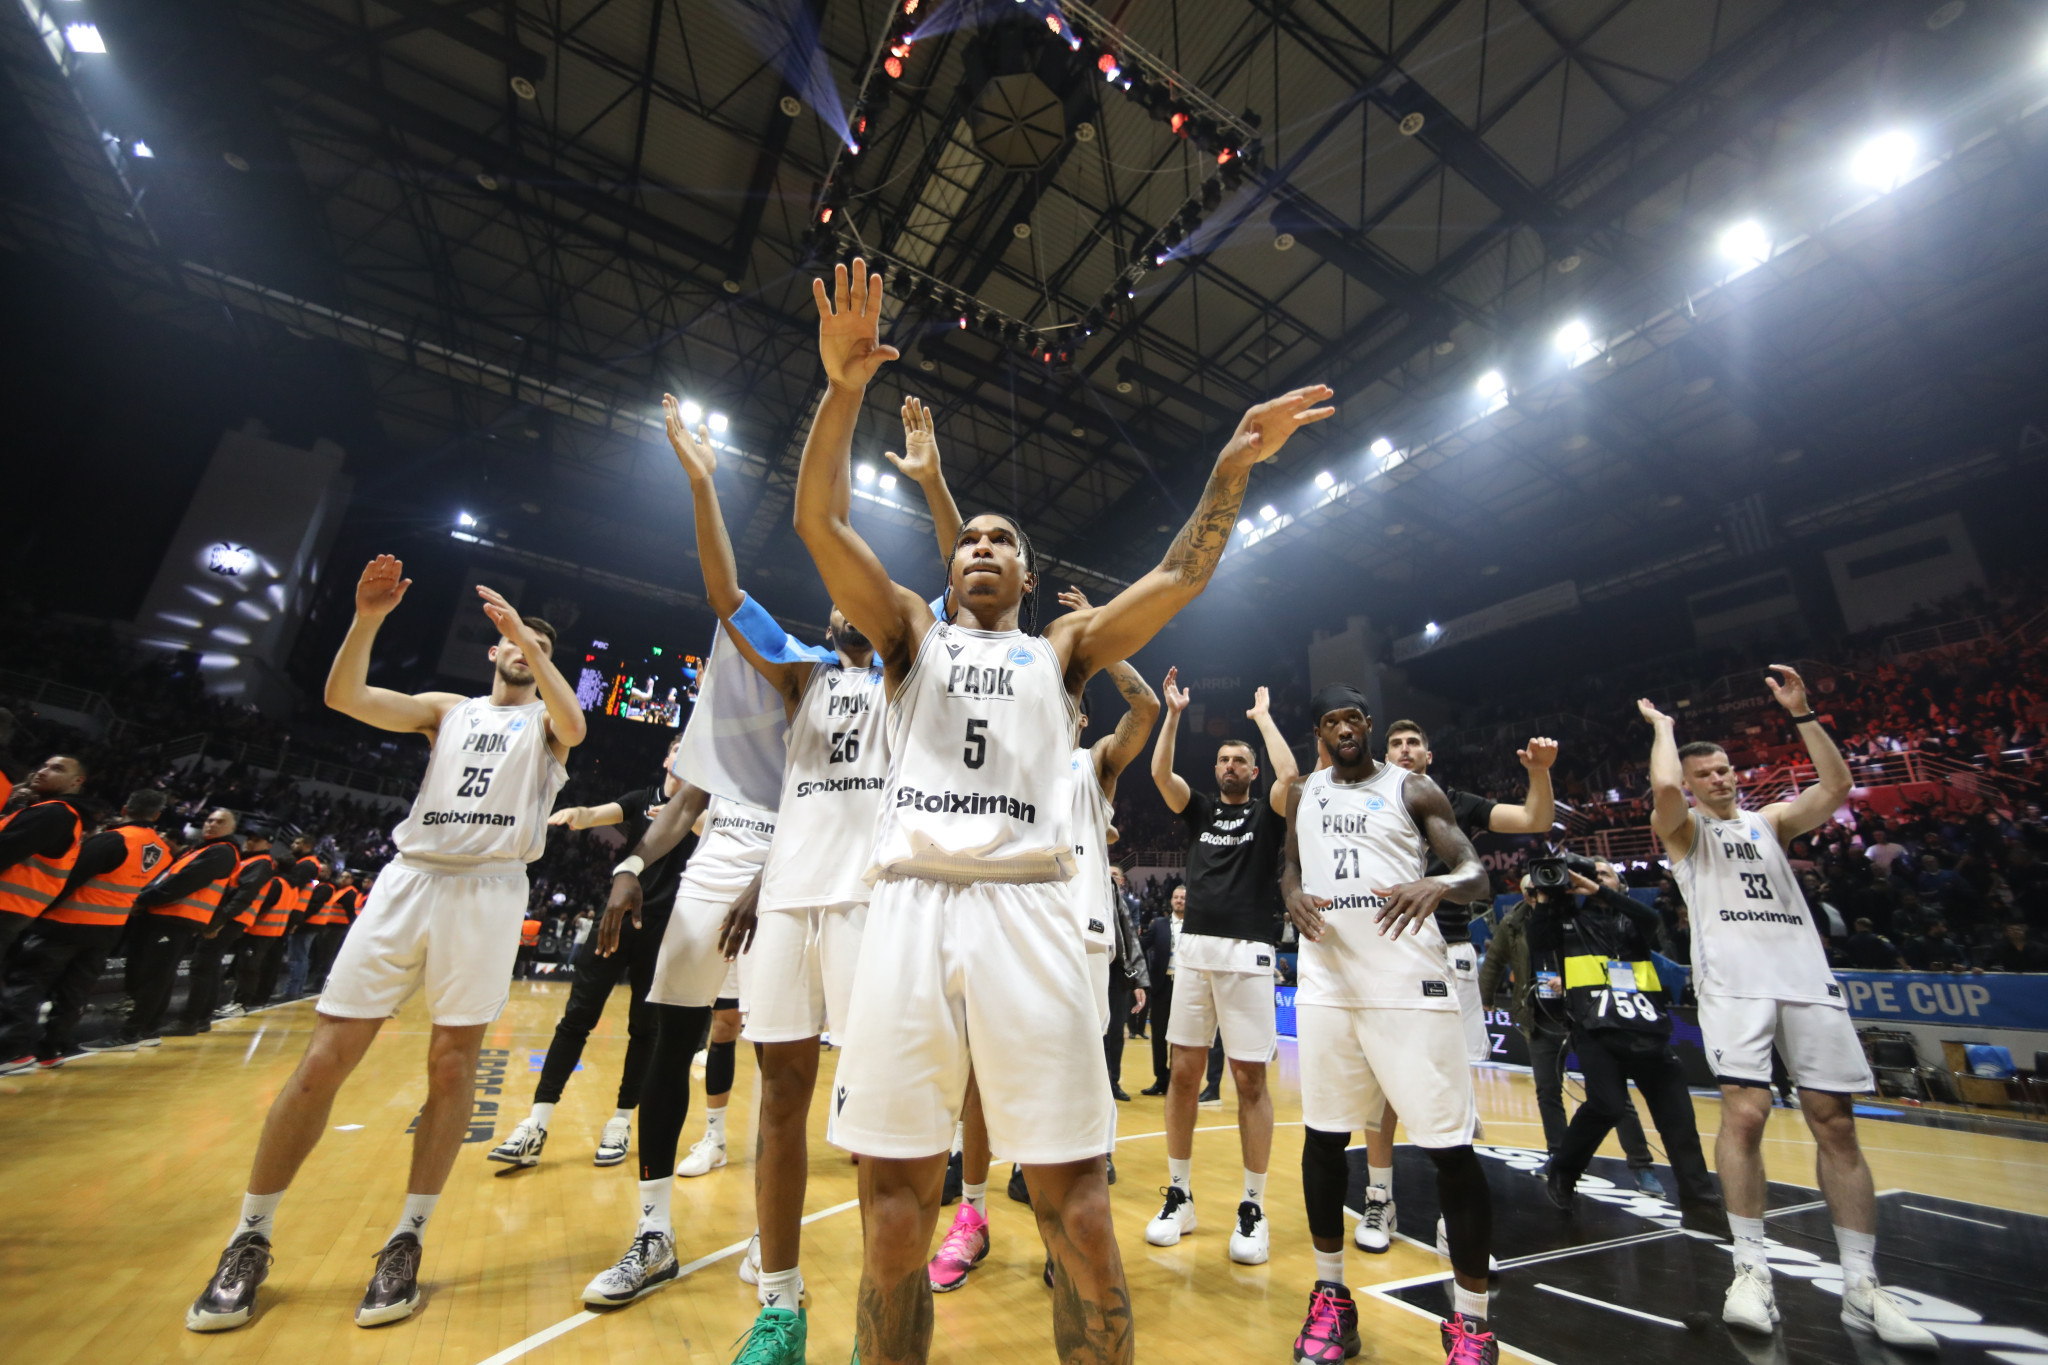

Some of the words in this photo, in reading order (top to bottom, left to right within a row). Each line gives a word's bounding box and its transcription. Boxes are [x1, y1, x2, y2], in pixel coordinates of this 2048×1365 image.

[947, 664, 1015, 697] PAOK
[462, 733, 511, 753] PAOK
[829, 729, 860, 764] 26
[963, 718, 988, 770] 5
[457, 766, 494, 798] 25
[422, 809, 516, 827] Stoiximan
[896, 786, 1036, 824] Stoiximan
[1322, 814, 1368, 834] PAOK
[1333, 848, 1360, 880] 21
[1740, 872, 1773, 900] 33
[1719, 909, 1803, 925] Stoiximan
[1590, 989, 1658, 1021] 759
[1906, 982, 1990, 1016] CUP
